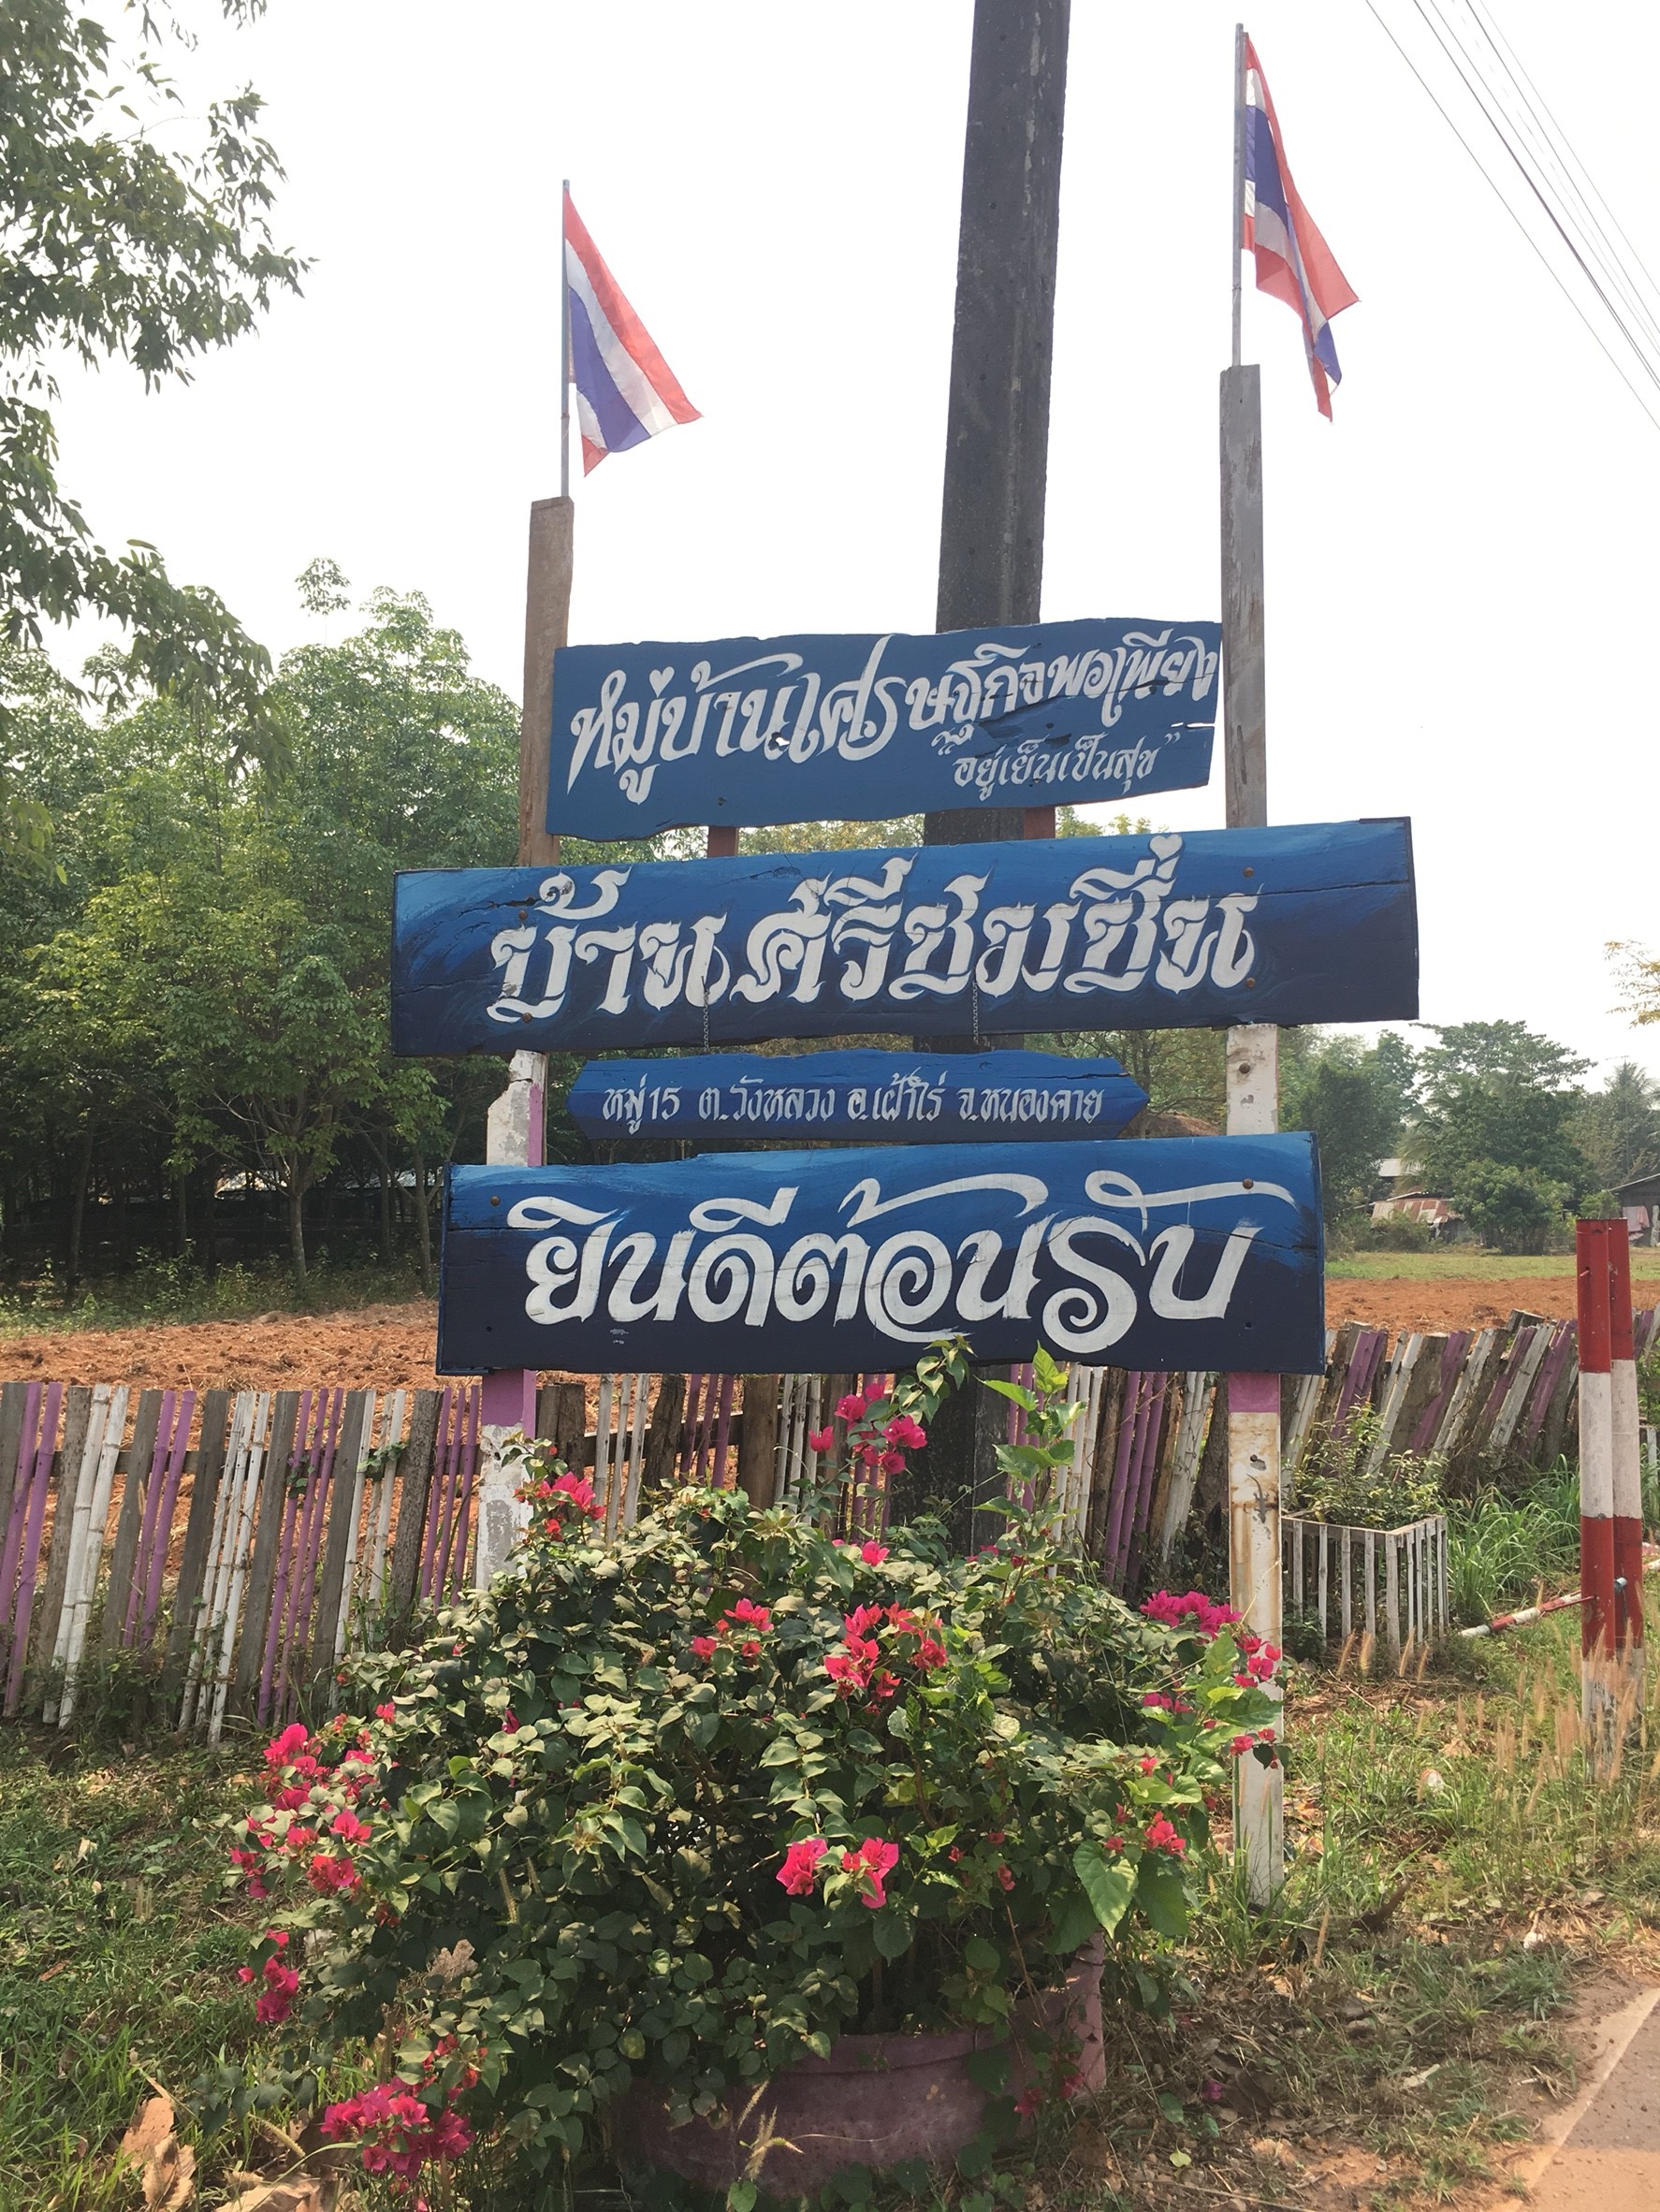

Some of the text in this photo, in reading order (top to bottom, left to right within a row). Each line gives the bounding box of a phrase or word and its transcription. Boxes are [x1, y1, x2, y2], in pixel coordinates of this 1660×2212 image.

[486, 833, 1265, 1023] บ้านศรีชมชื่น
[698, 1075, 835, 1122] ต.วังหลวง
[956, 1086, 1105, 1124] จ.หนองคาย
[506, 1170, 1301, 1354] ยินดีต้อนรับ
